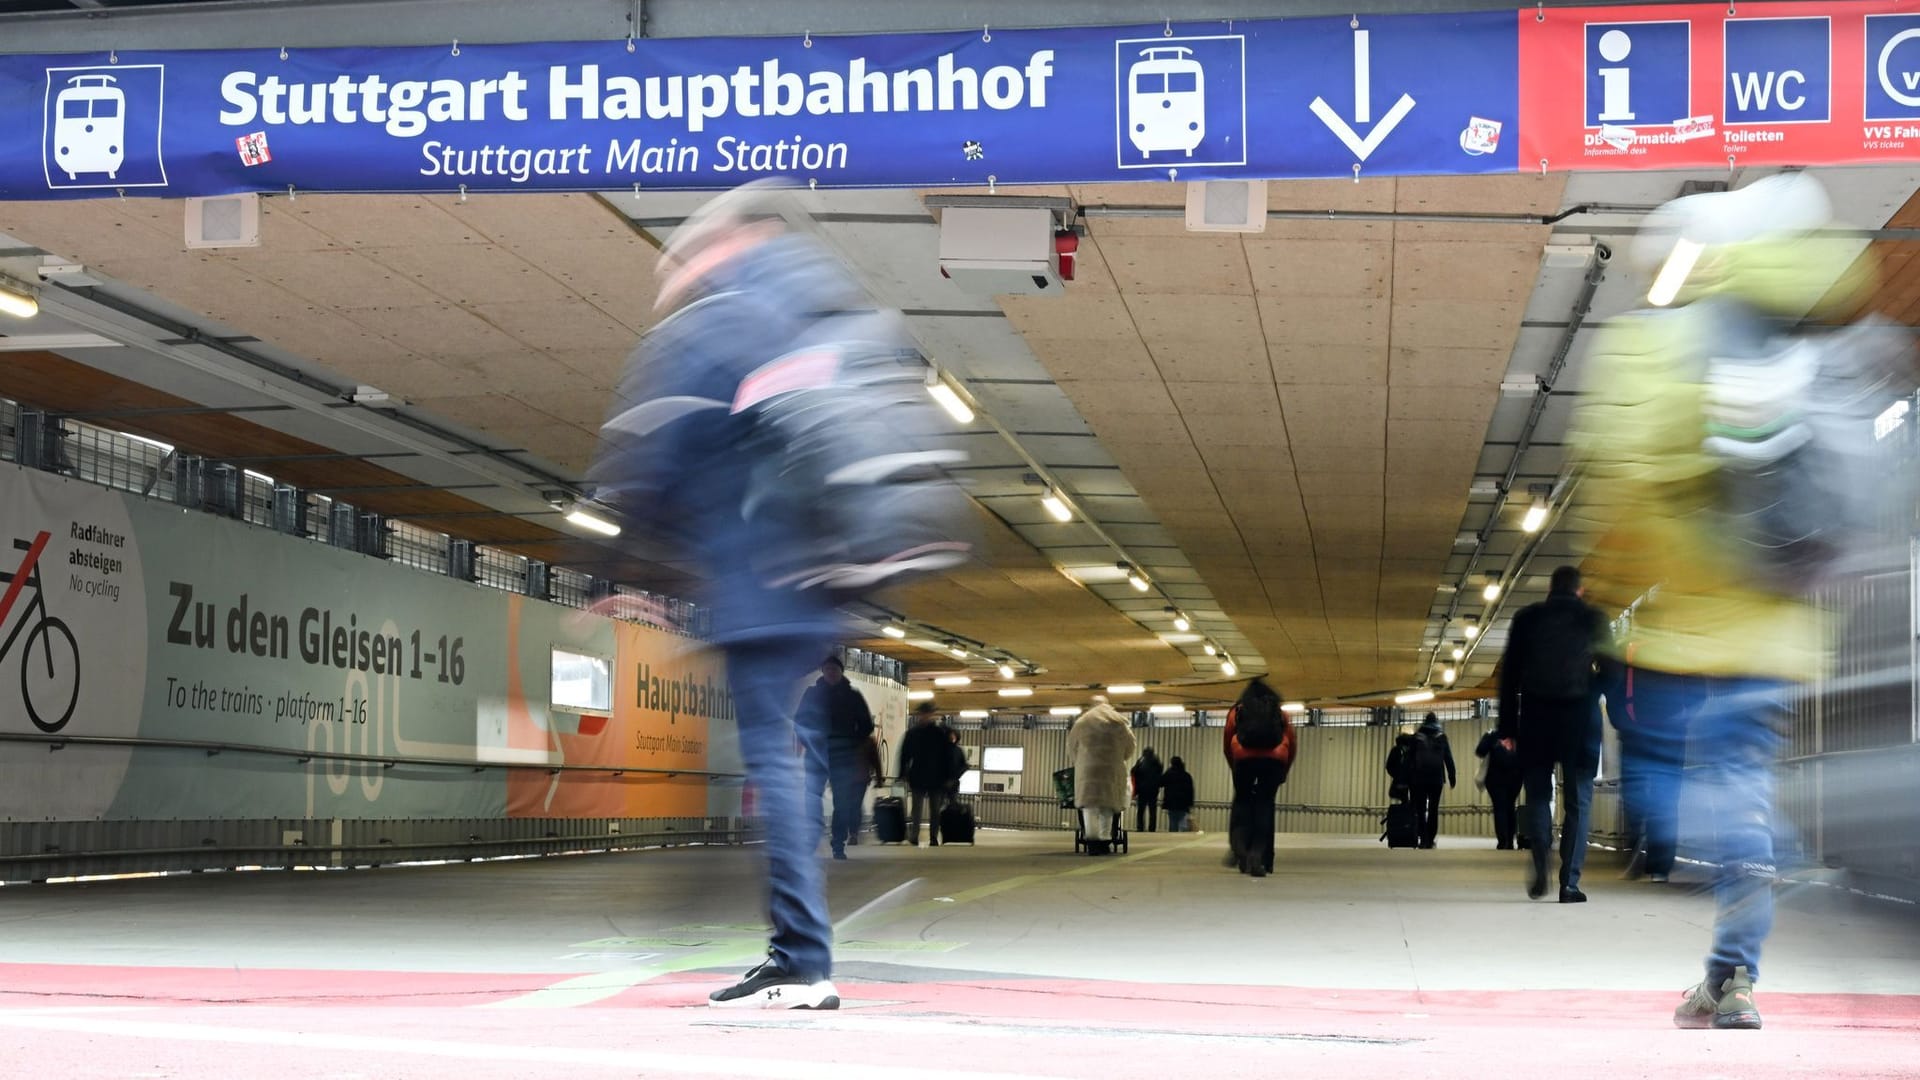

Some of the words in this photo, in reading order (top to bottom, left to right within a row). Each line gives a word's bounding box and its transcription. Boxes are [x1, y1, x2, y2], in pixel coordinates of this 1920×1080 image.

[220, 71, 528, 138] Stuttgart
[549, 50, 1054, 132] Hauptbahnhof
[1732, 70, 1806, 111] WC
[1723, 130, 1784, 142] Toiletten
[1863, 126, 1891, 139] VVS
[1894, 126, 1920, 139] Fah
[1863, 141, 1879, 149] VVS
[1880, 141, 1904, 149] tickets
[421, 141, 591, 183] Stuttgart
[605, 138, 699, 173] Main
[713, 135, 848, 172] Station
[1630, 147, 1648, 155] desk
[1723, 144, 1747, 153] Toilets
[70, 521, 125, 548] Radfahrer
[69, 548, 122, 575] absteigen
[69, 574, 83, 592] No
[85, 579, 120, 602] cycling
[167, 581, 215, 648] Zu
[227, 594, 288, 660] den
[299, 607, 402, 676] Gleisen
[167, 677, 187, 708] To
[191, 680, 217, 711] the
[221, 686, 263, 715] trains
[275, 691, 334, 725] platform
